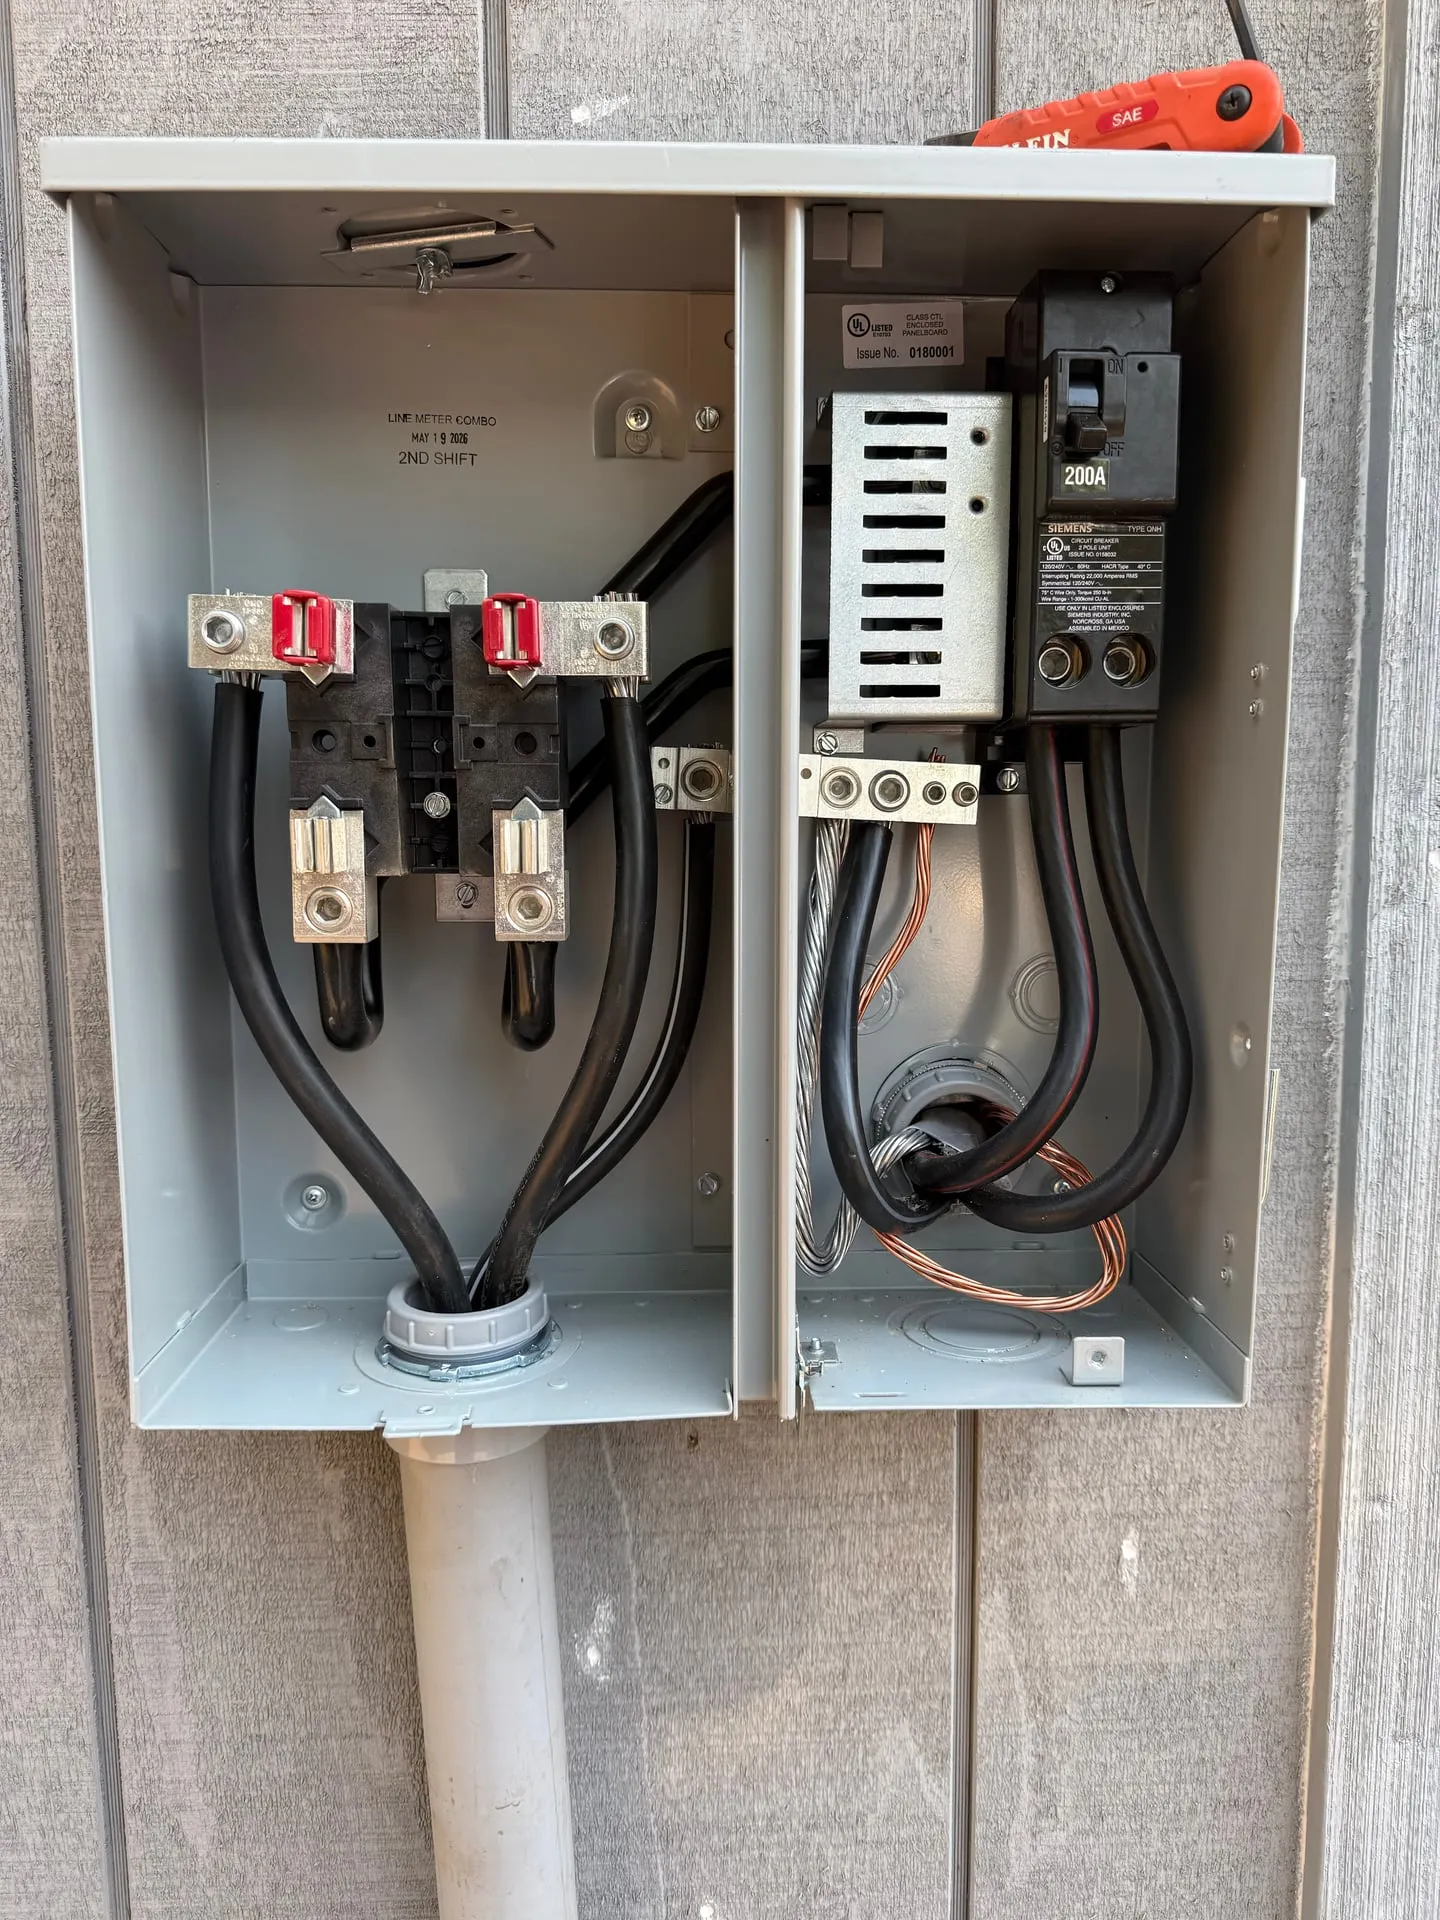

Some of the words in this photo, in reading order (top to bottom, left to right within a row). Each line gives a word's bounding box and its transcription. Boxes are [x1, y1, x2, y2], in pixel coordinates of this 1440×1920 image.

[1112, 106, 1143, 126] SAE
[857, 347, 881, 359] Issue
[883, 347, 899, 358] No.
[909, 346, 954, 358] 0180001
[388, 413, 412, 423] LINE
[415, 414, 452, 424] METER
[455, 415, 496, 426] COMBO
[412, 432, 429, 443] MAY
[450, 432, 468, 444] 2026
[399, 452, 429, 465] 2ND
[434, 452, 478, 466] SHIFT
[1064, 466, 1106, 485] 200A
[1048, 524, 1092, 533] SIEMENS
